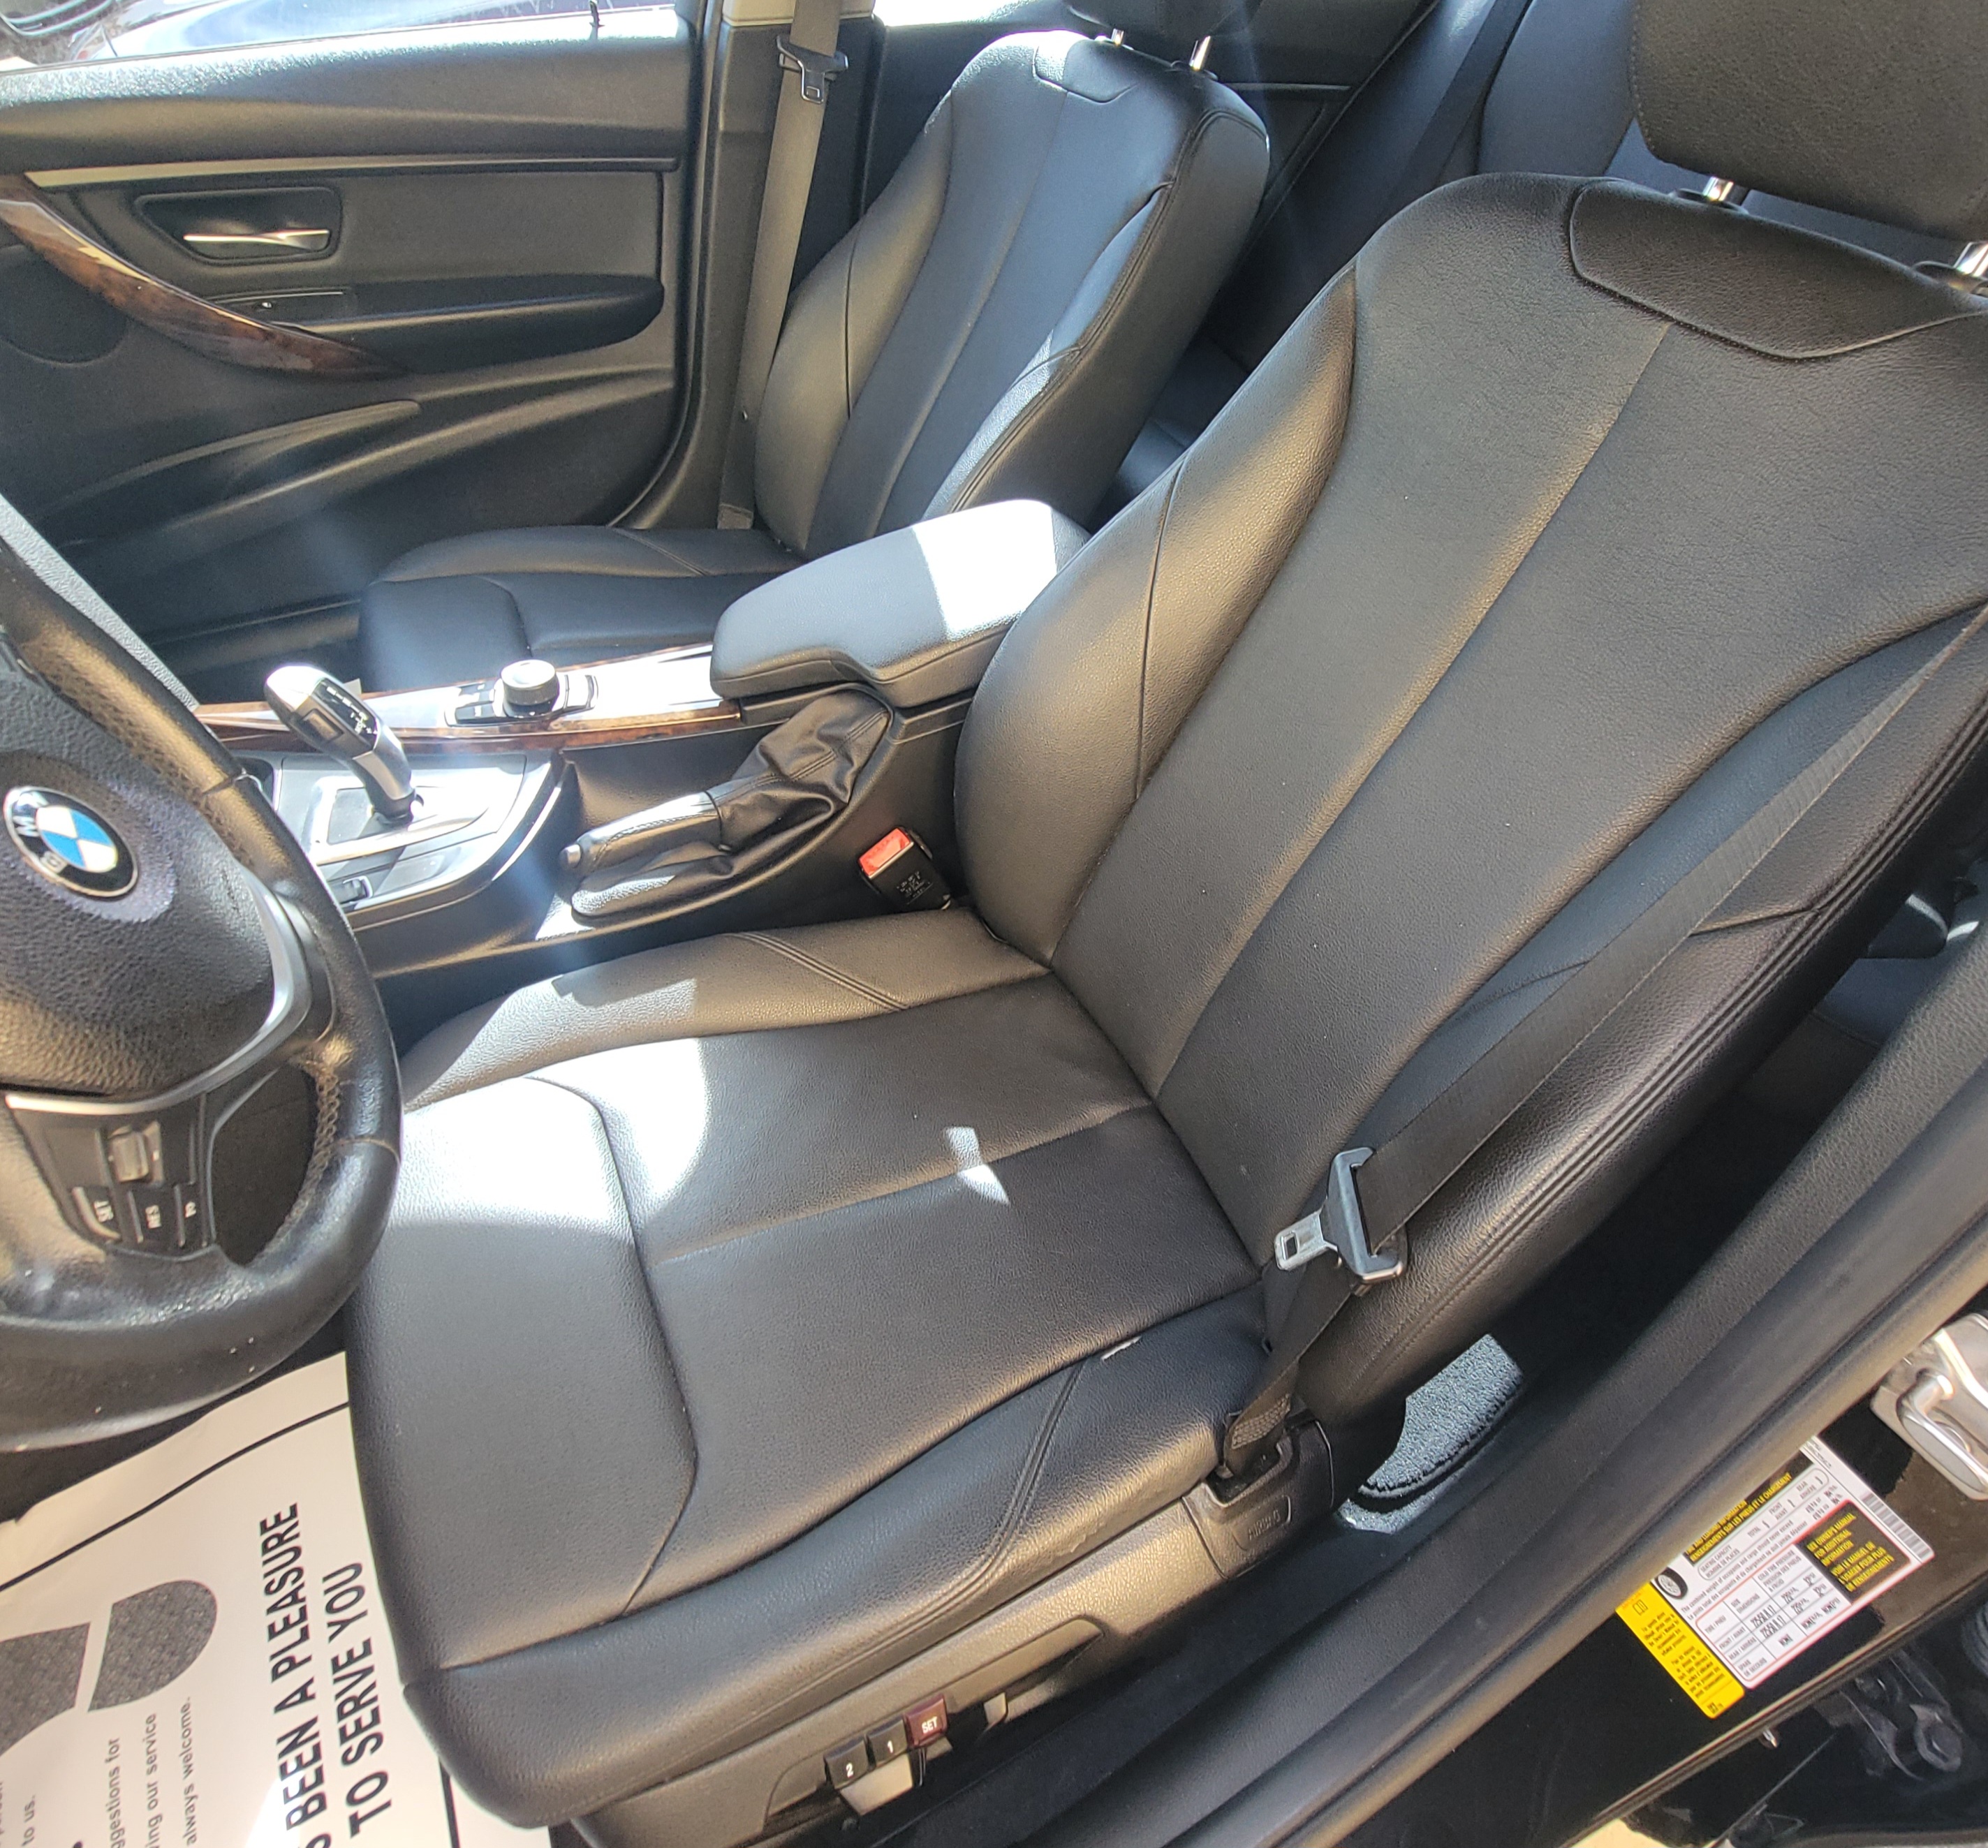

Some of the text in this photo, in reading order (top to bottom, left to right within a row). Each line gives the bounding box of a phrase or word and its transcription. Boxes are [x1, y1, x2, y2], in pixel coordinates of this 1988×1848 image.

[259, 1502, 312, 1683] PLEASURE
[274, 1676, 316, 1714] A
[322, 1562, 392, 1839] TO SERVE YOU
[142, 1713, 157, 1776] service
[887, 1740, 894, 1753] 1
[921, 1716, 938, 1734] SET
[104, 1738, 120, 1764] for
[179, 1697, 199, 1846] always welcome.
[276, 1715, 327, 1831] BEEN
[846, 1763, 853, 1777] 2
[147, 1781, 159, 1811] our
[21, 1795, 35, 1847] to us.
